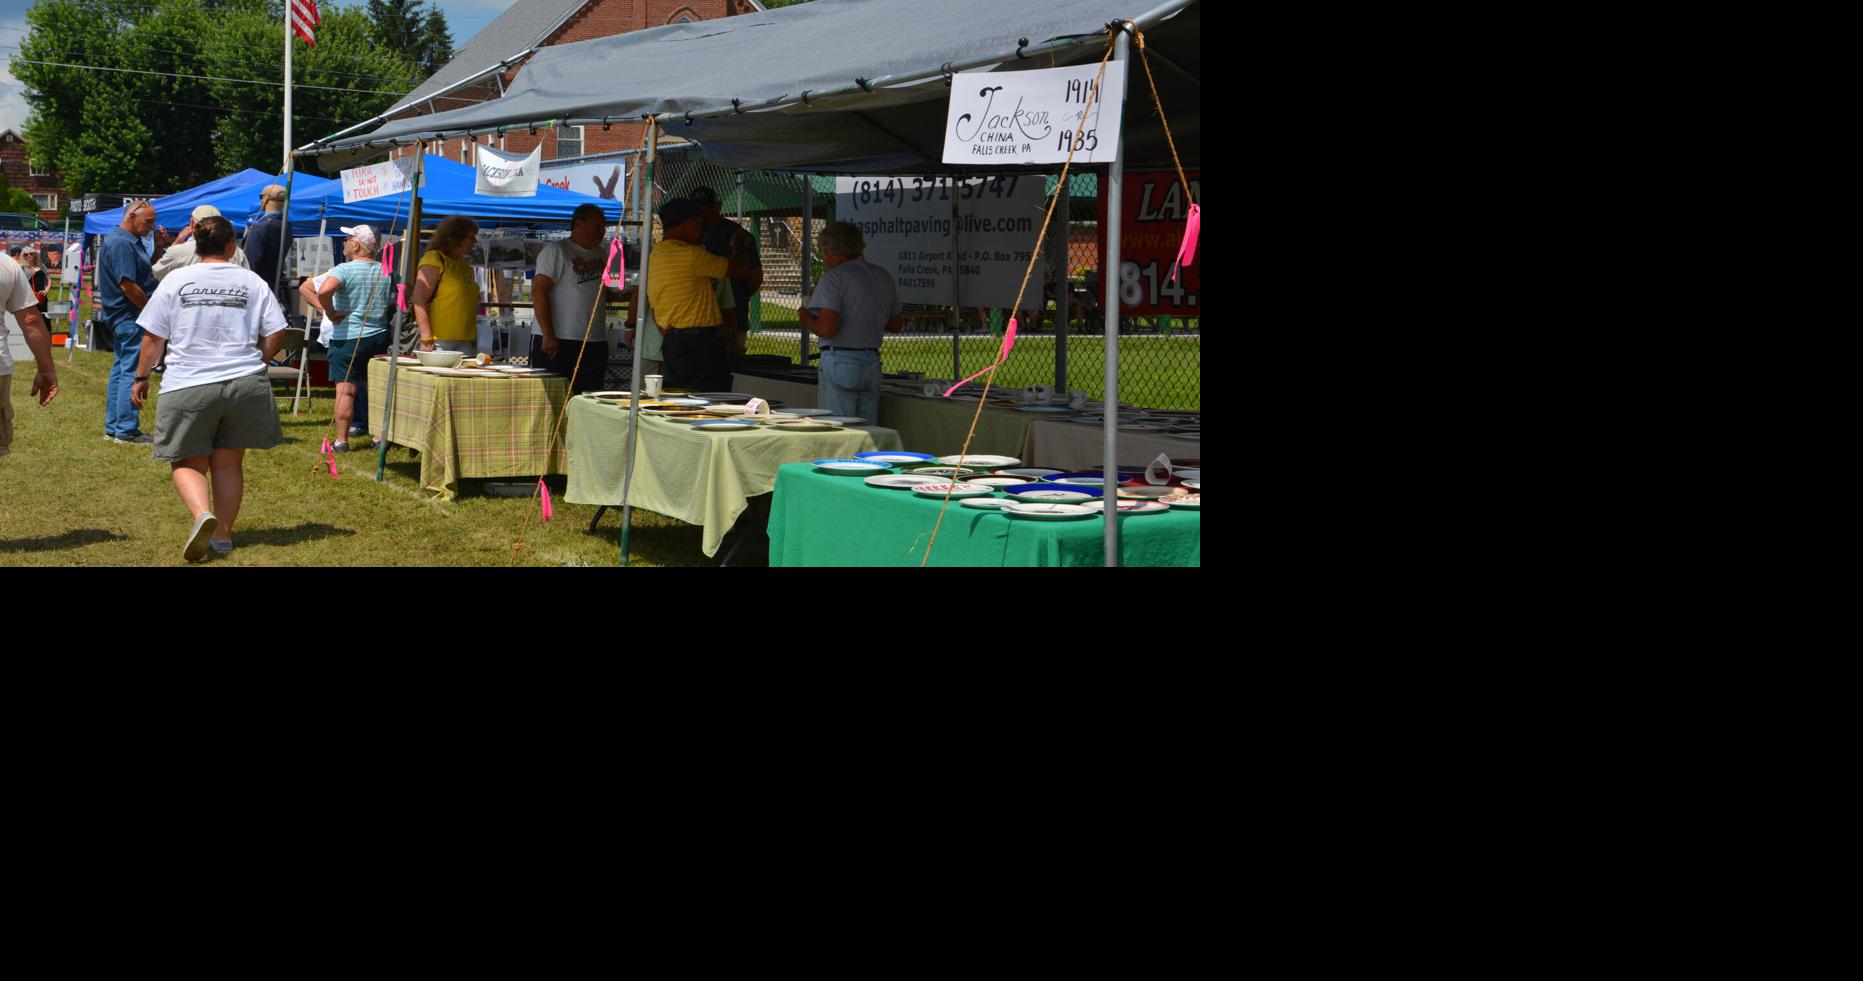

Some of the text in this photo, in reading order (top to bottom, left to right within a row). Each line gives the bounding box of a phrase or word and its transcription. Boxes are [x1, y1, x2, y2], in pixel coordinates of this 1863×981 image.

[956, 86, 1051, 142] Jackson
[980, 132, 1014, 142] CHINA
[971, 145, 993, 155] FALLS
[1021, 143, 1031, 153] PA
[353, 186, 380, 199] TOUCH
[852, 178, 904, 210] (814)
[898, 251, 916, 261] 1811
[918, 250, 945, 263] Airport
[946, 250, 967, 262] Rad
[974, 251, 992, 262] P.O.
[994, 251, 1011, 262] Box
[898, 265, 915, 275] Falls
[959, 266, 980, 276] 5840
[179, 282, 249, 298] Corvette
[898, 278, 936, 289] PA017596
